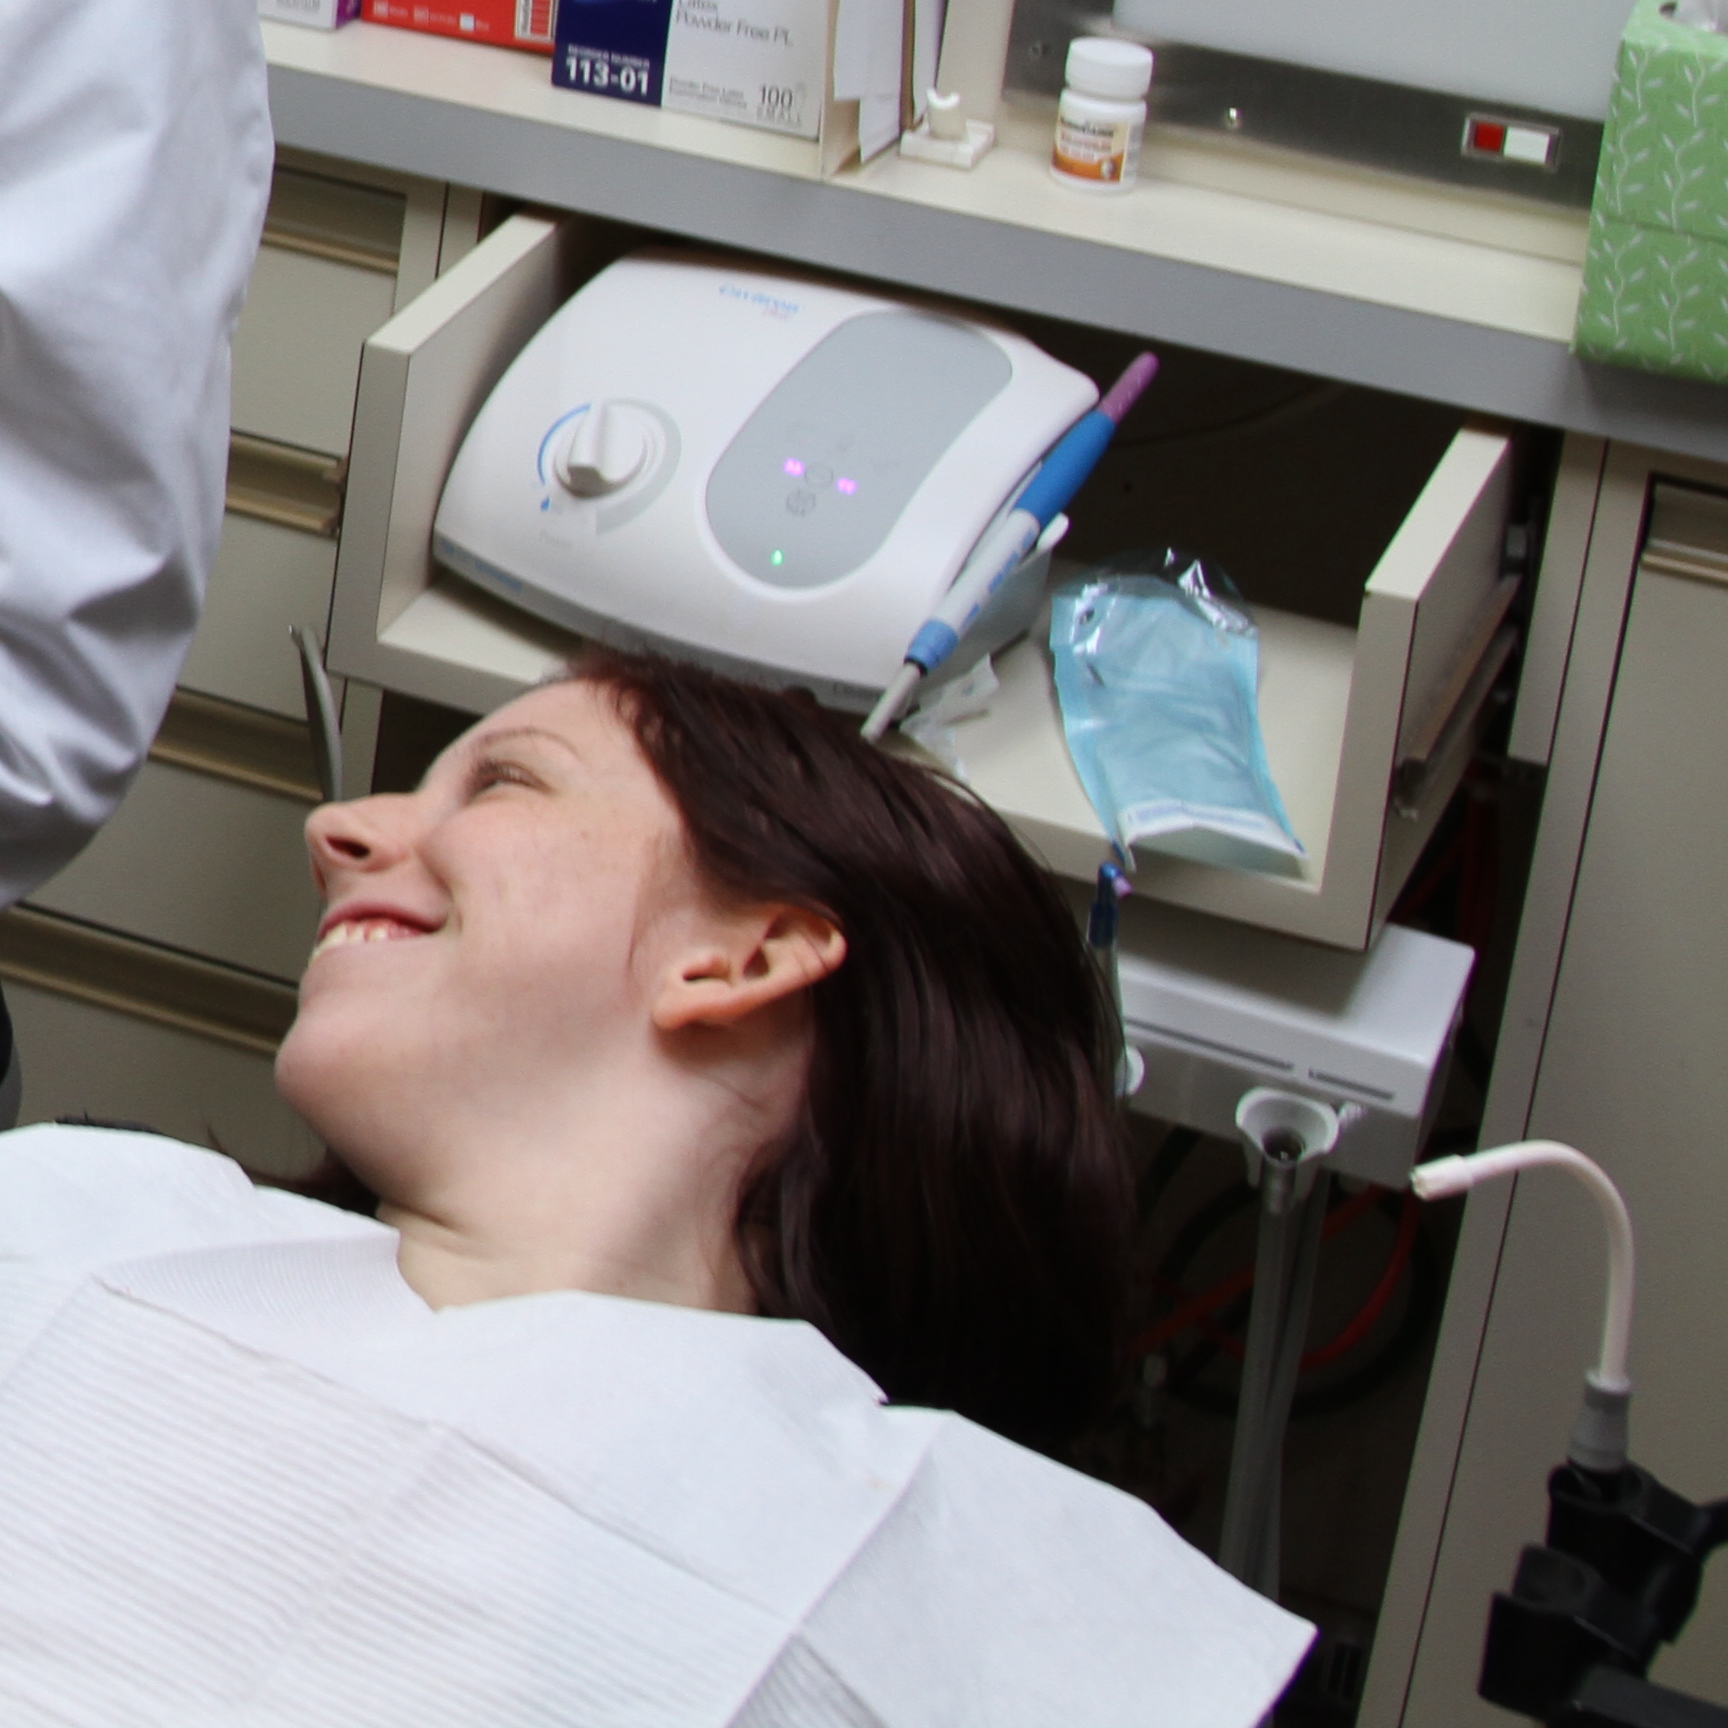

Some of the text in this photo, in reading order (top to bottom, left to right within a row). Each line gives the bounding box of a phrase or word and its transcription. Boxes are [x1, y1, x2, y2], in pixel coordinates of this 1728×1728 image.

[676, 9, 792, 47] Powder Free PL
[565, 55, 649, 96] 113-01
[759, 82, 794, 109] 100
